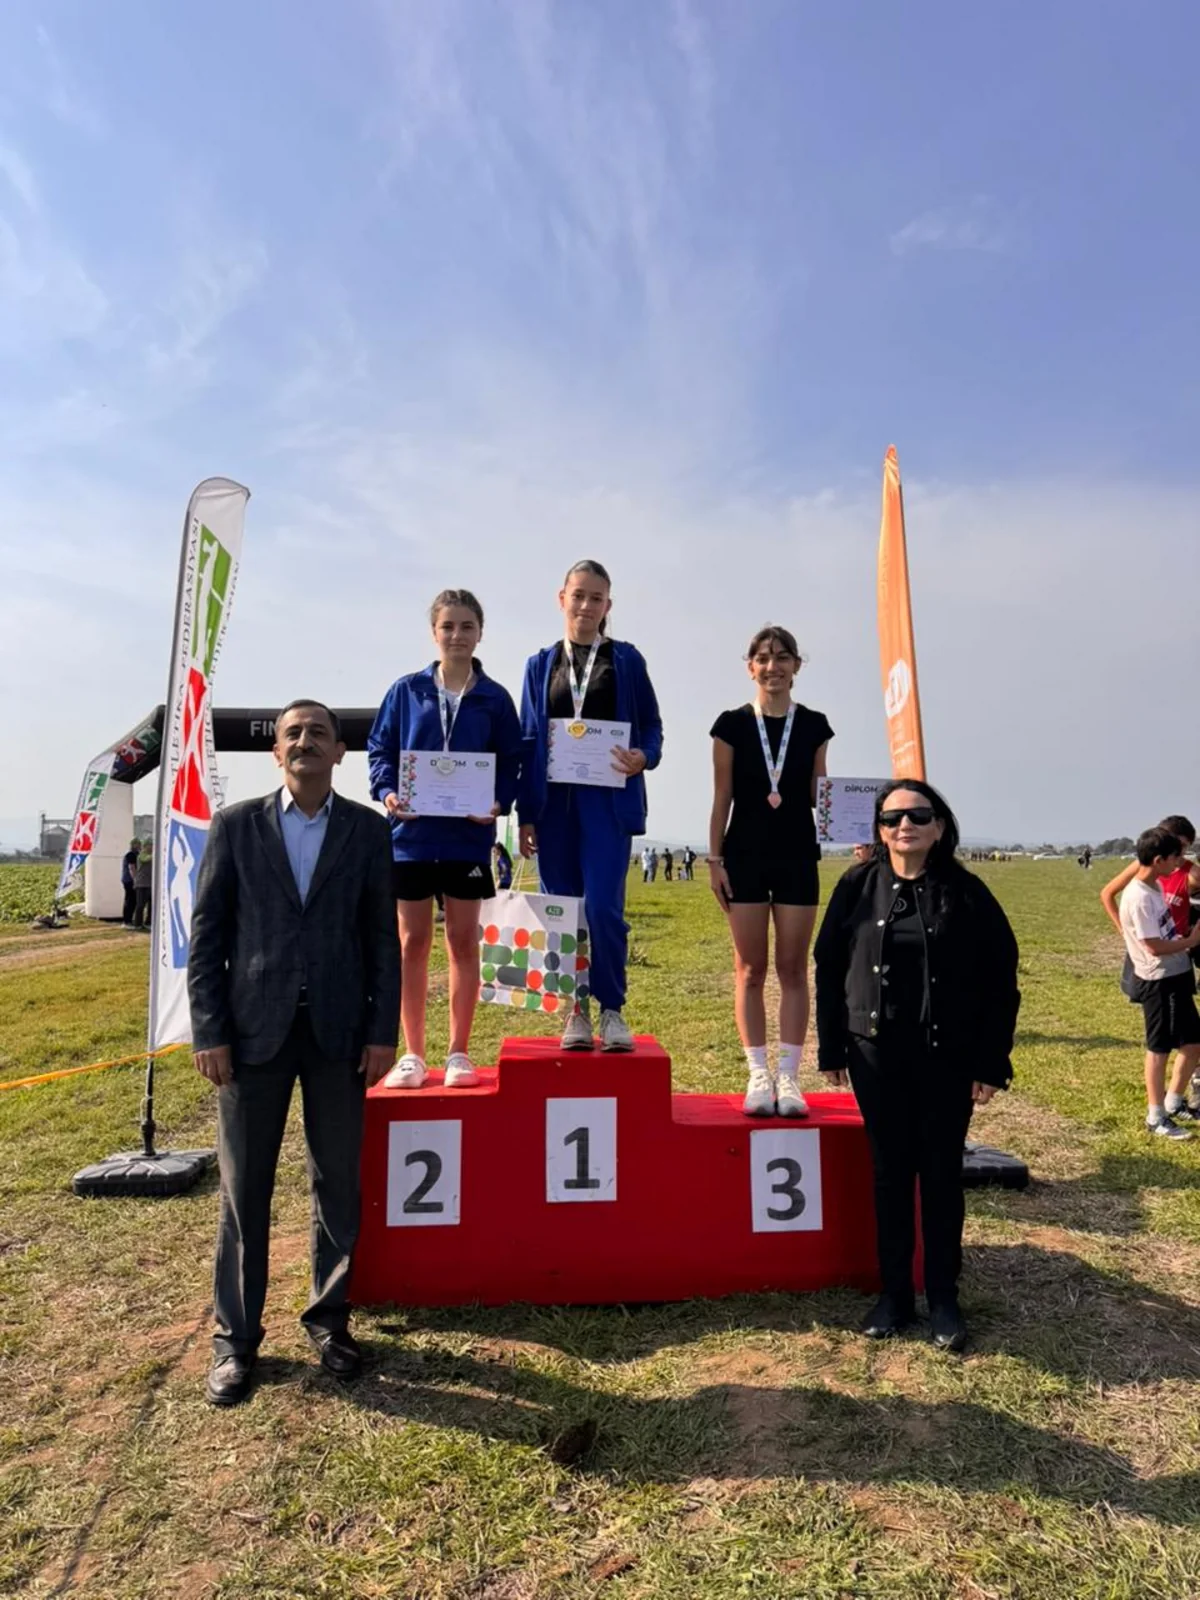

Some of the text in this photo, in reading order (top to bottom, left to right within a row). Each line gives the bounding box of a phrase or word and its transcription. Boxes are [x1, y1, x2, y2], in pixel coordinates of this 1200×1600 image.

[403, 1149, 444, 1214] 2
[563, 1126, 601, 1190] 1
[765, 1157, 807, 1221] 3
